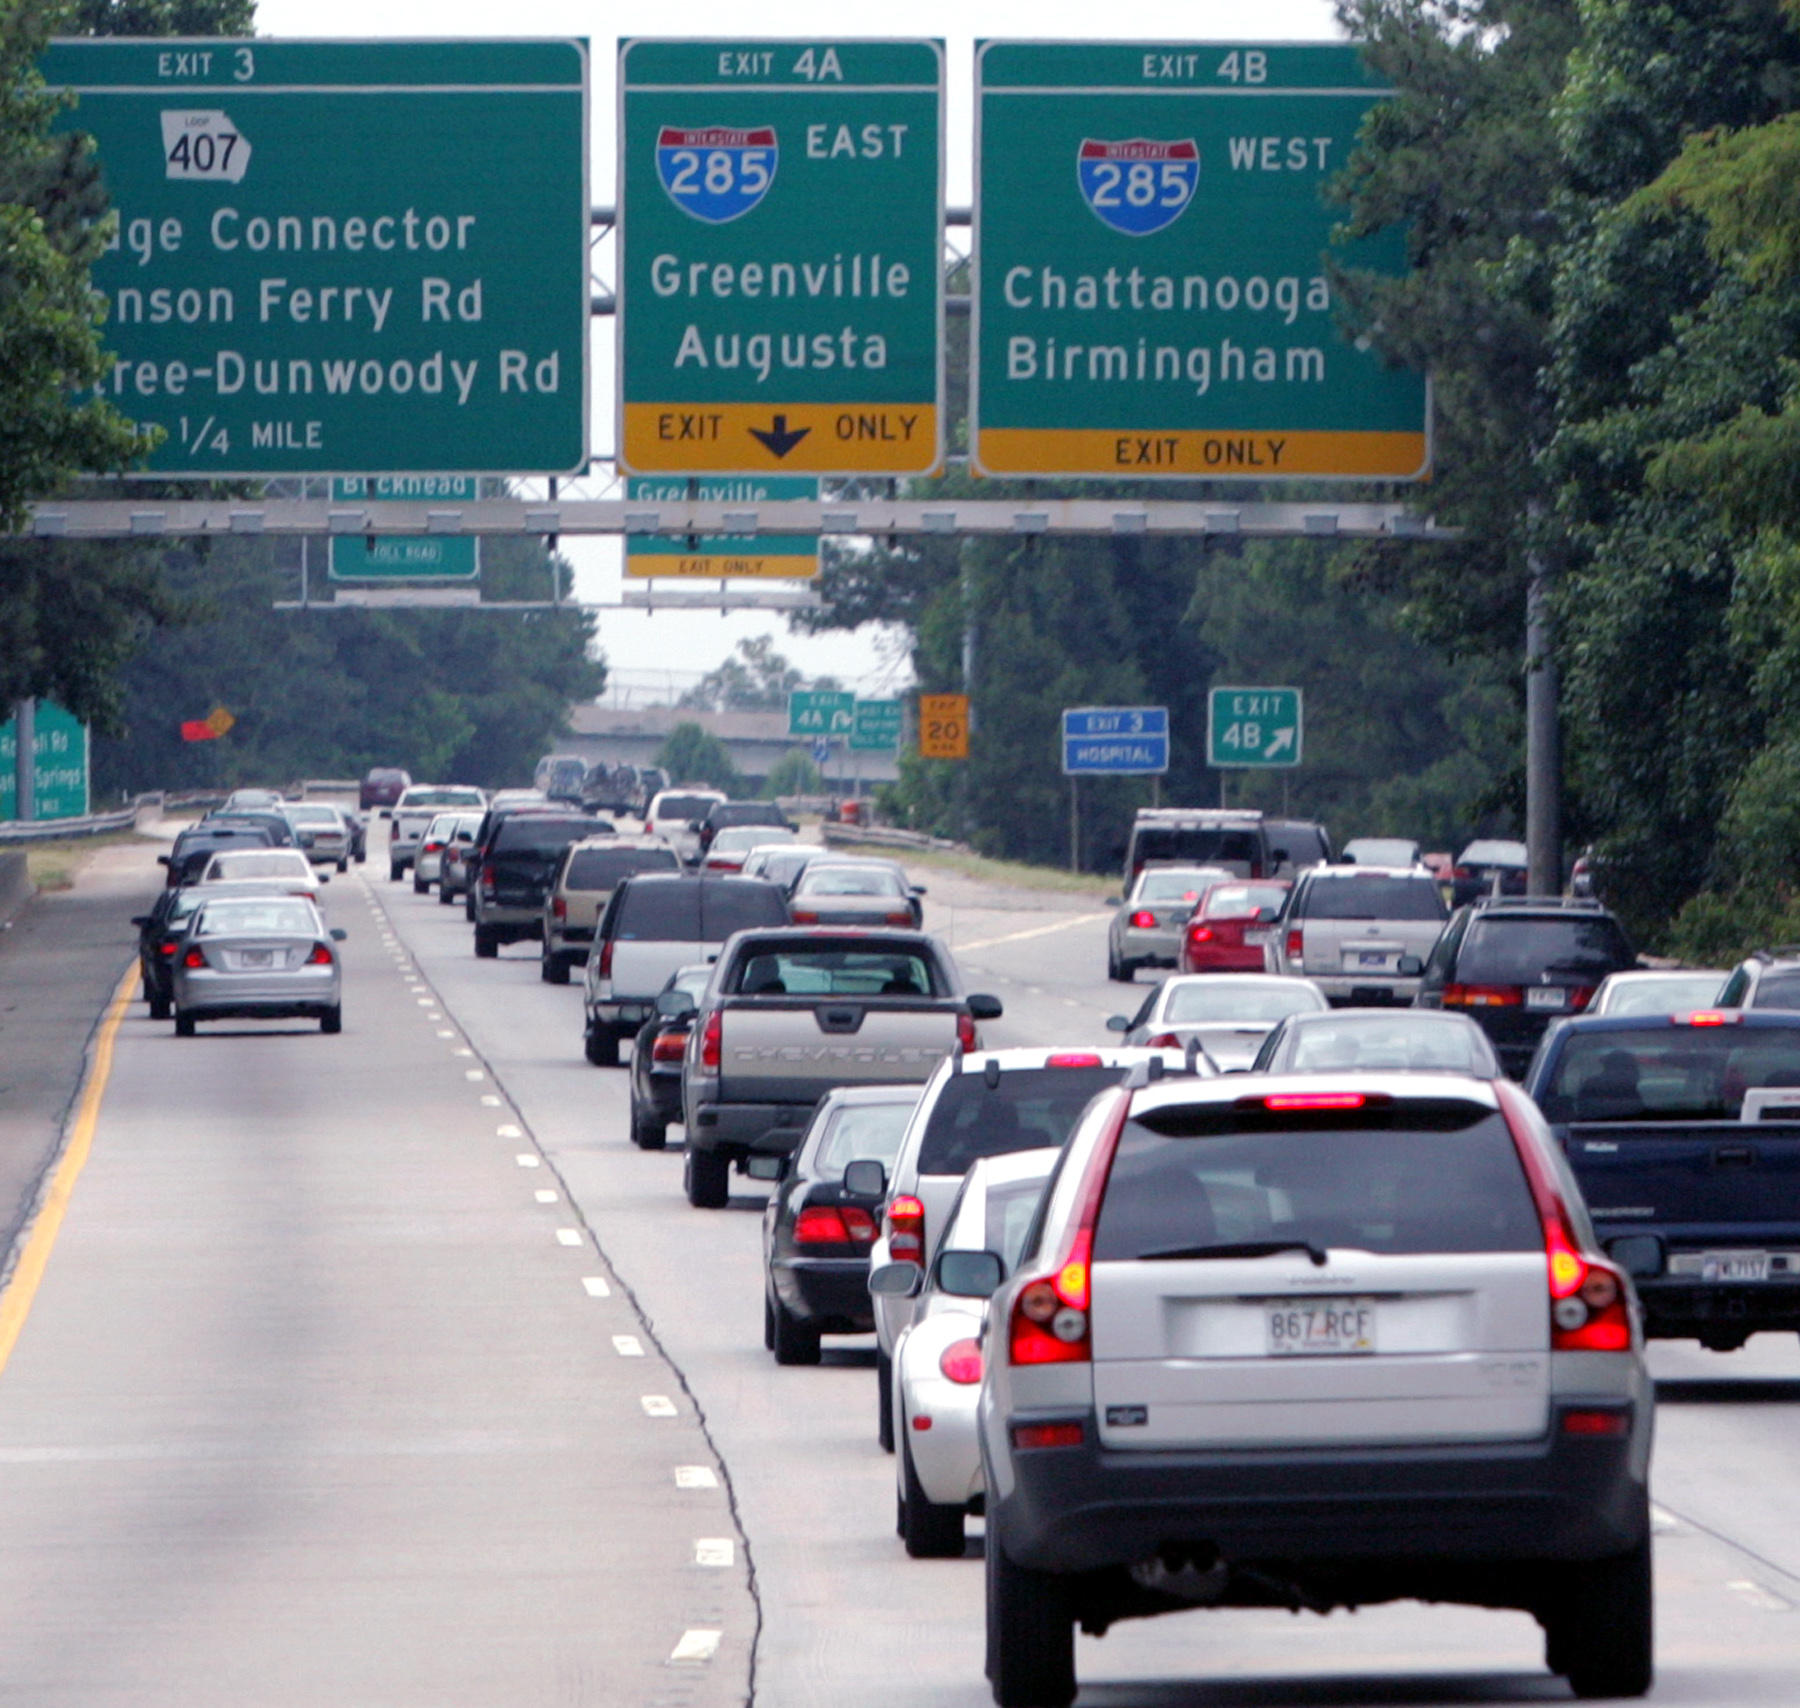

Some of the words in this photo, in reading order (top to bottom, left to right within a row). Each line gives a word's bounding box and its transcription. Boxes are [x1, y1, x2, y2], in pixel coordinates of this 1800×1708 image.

[158, 52, 213, 77] EXIT
[234, 48, 255, 81] 3
[718, 52, 773, 76] EXIT
[793, 48, 843, 82] 4A
[1143, 54, 1199, 78] EXIT
[1217, 51, 1267, 83] 4B
[185, 118, 210, 127] LOOP
[169, 133, 237, 172] 407
[807, 124, 908, 159] EAST
[1106, 145, 1169, 158] INTERSTATE
[1229, 137, 1332, 171] WEST
[671, 151, 768, 195] 285
[1092, 163, 1190, 207] 285
[211, 207, 476, 251] Connector
[651, 254, 910, 298] Greenville
[260, 278, 393, 332] Ferry
[422, 278, 483, 322] Rd
[1004, 266, 1330, 325] Chattanooga
[674, 325, 887, 382] Augusta
[1007, 337, 1325, 396] Birmingham
[500, 349, 560, 393] Rd
[180, 415, 230, 455] 1/4
[252, 421, 323, 449] MILE
[658, 414, 723, 440] EXIT
[836, 414, 919, 440] ONLY
[1116, 438, 1179, 465] EXIT
[1204, 439, 1286, 466] ONLY
[678, 560, 711, 574] EXIT
[723, 560, 764, 574] ONLY
[1087, 714, 1120, 732] EXIT
[1130, 712, 1143, 733] 3
[1233, 697, 1283, 716] EXIT
[928, 721, 960, 741] 20
[1222, 722, 1260, 749] 4B
[1077, 747, 1154, 762] HOSPITAL
[734, 1046, 946, 1063] CHEVROLET
